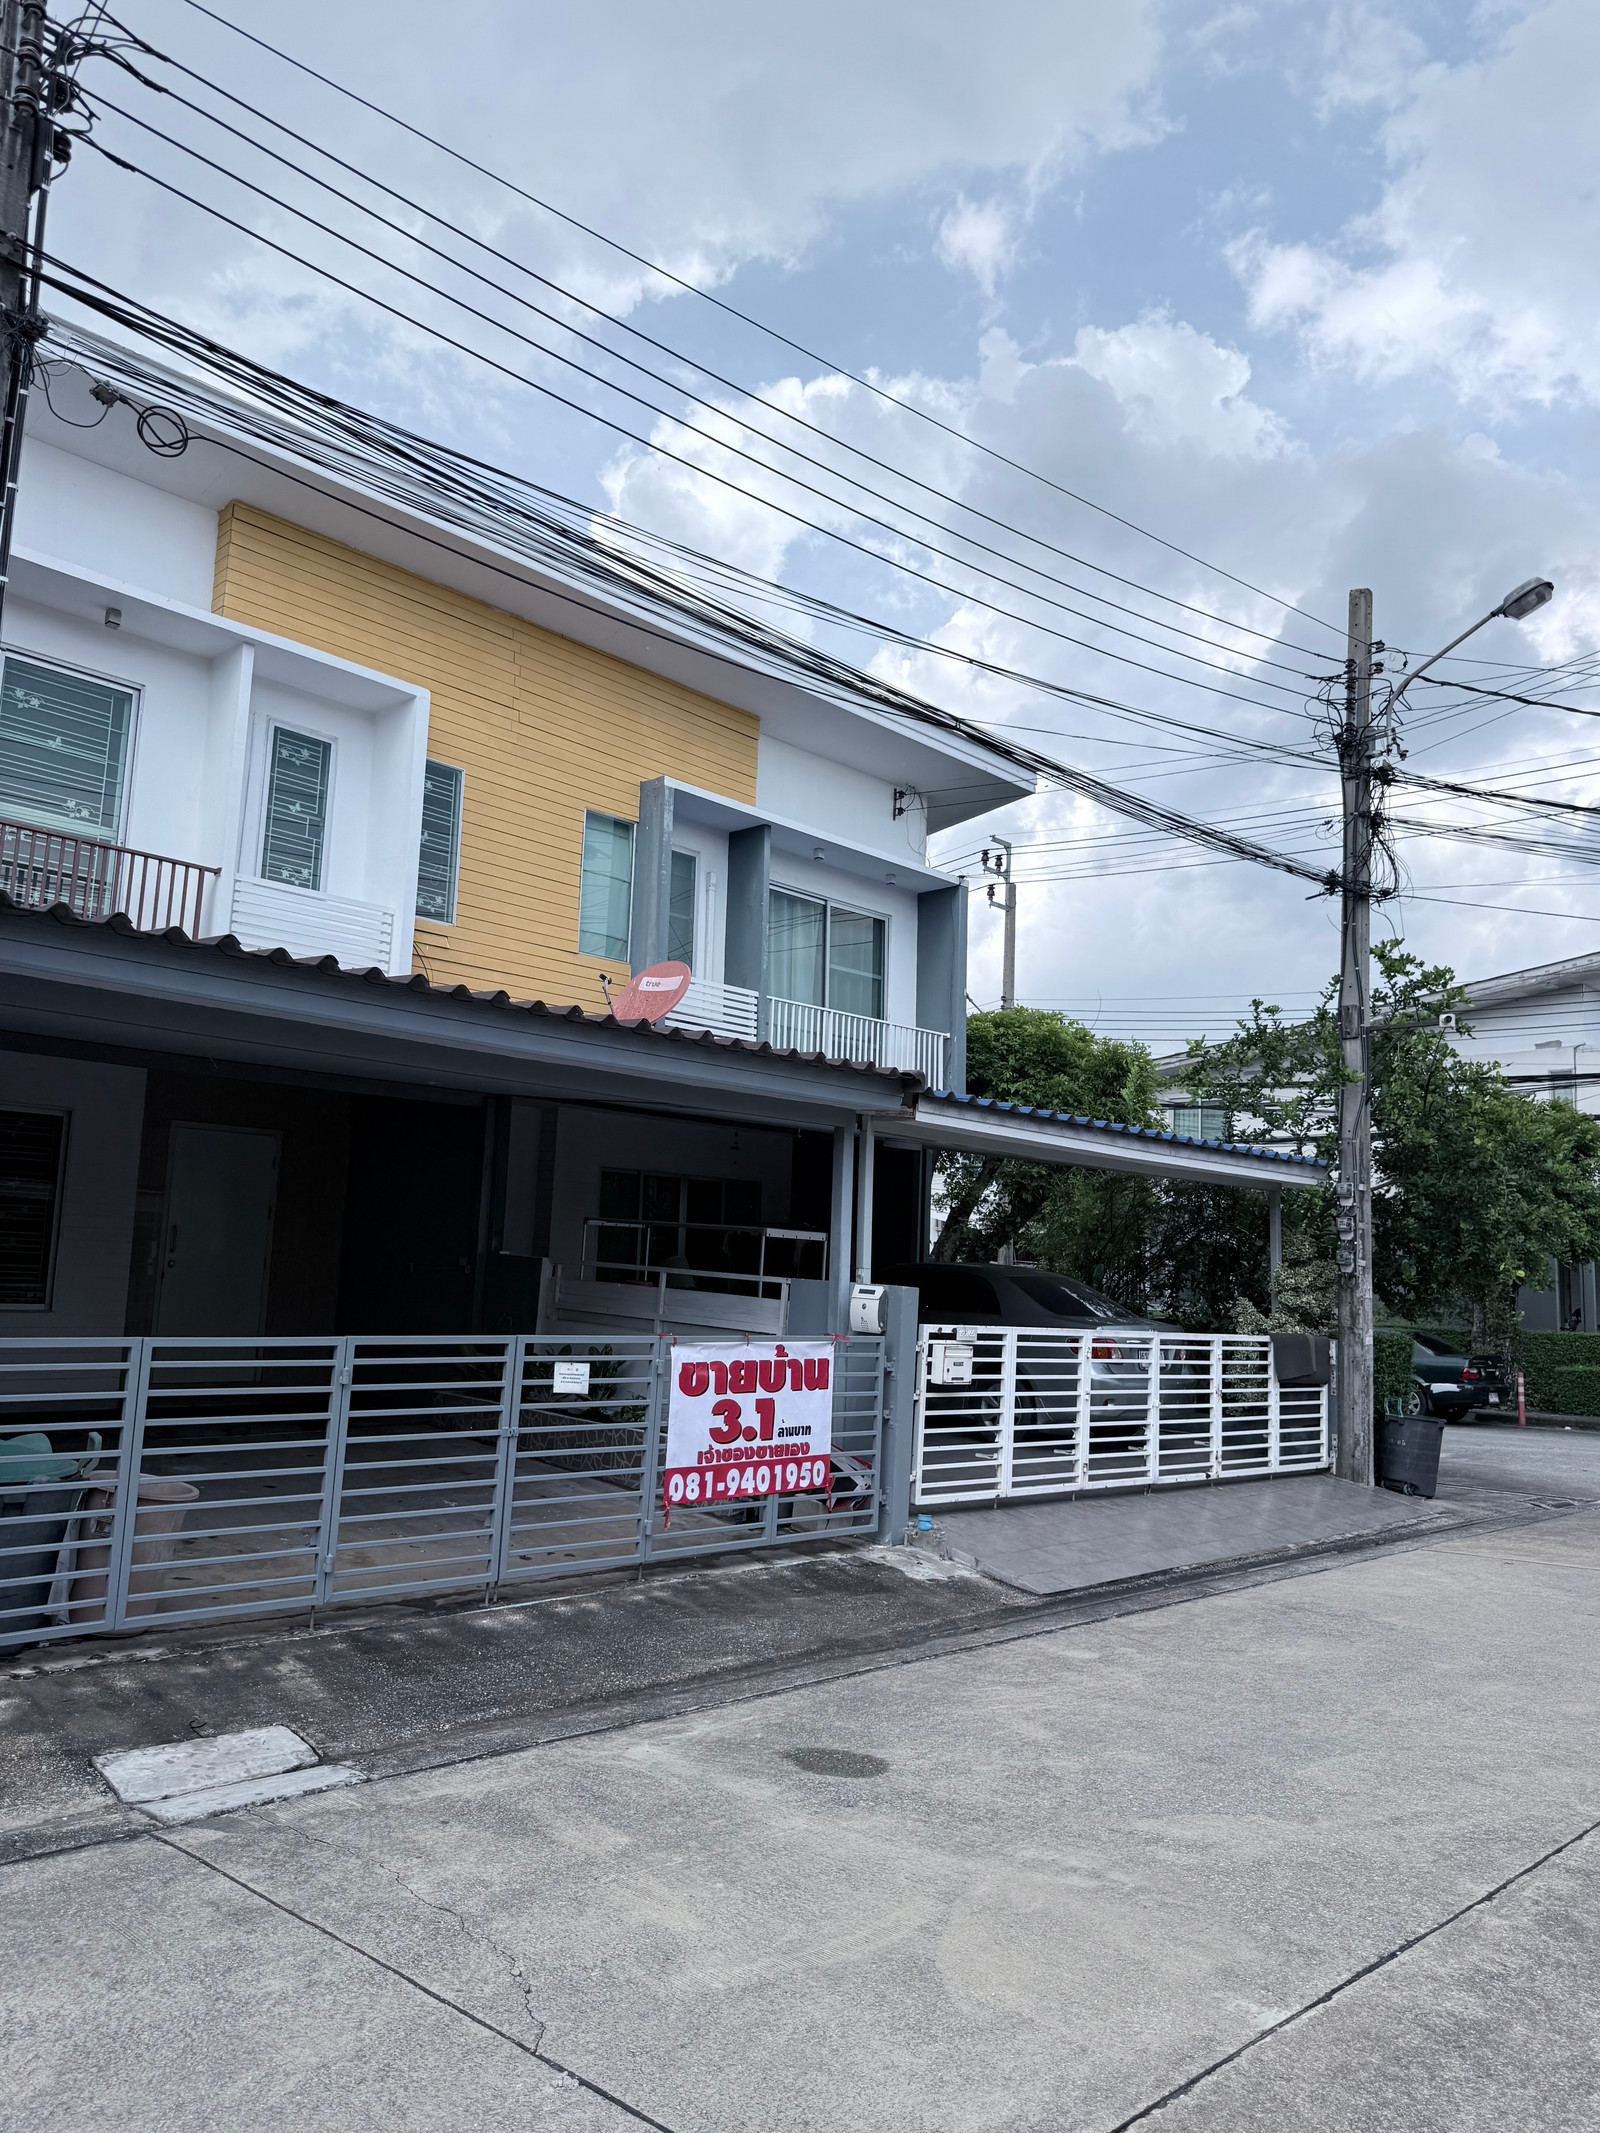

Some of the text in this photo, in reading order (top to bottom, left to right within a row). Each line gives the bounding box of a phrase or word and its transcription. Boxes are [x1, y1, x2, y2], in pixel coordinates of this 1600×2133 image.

[678, 1344, 830, 1397] ขายบ้าน
[709, 1398, 812, 1444] 3.1 ล้านบาท
[697, 1442, 811, 1465] เจ้าของขายเอง
[668, 1460, 826, 1502] 081-9401950
